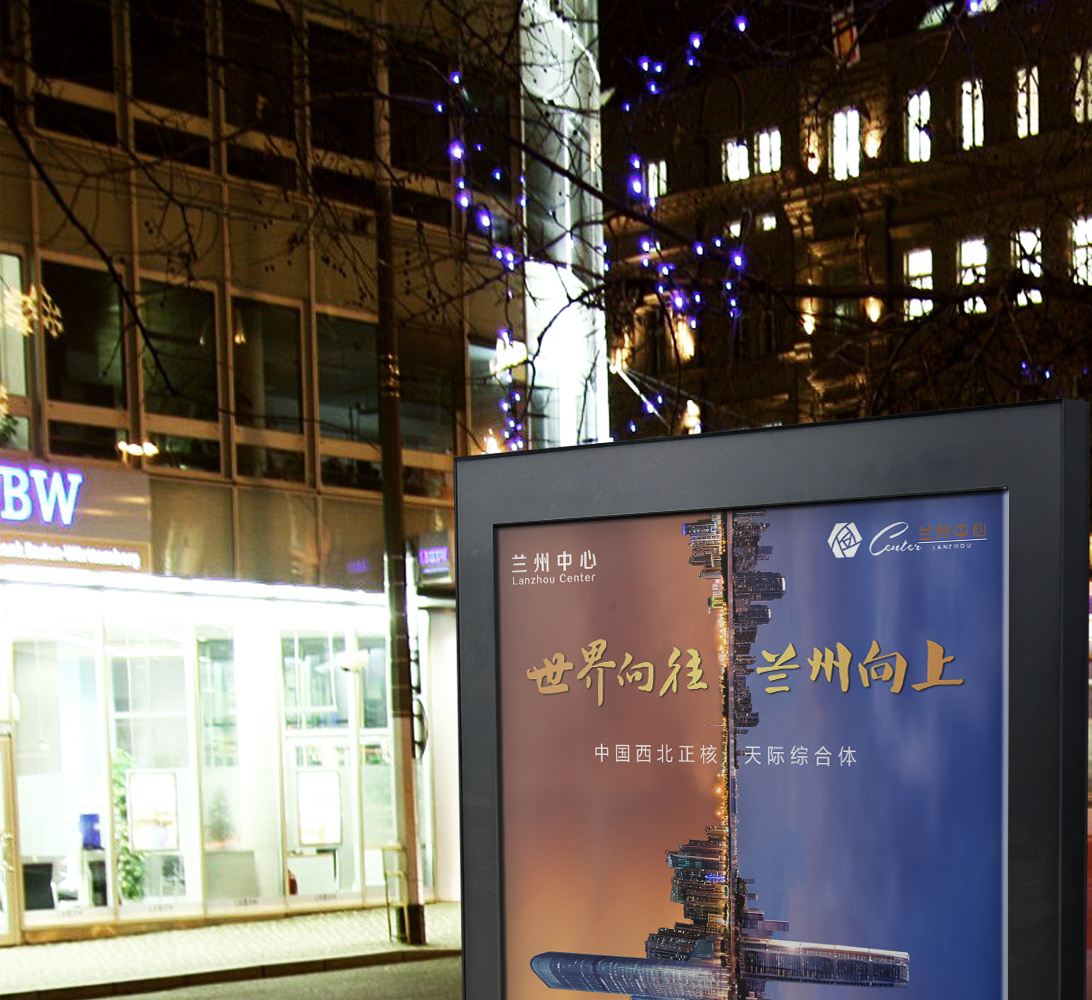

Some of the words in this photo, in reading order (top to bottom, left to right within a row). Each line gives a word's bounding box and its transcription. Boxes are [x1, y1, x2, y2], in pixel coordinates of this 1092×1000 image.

[869, 521, 923, 556] Center
[918, 521, 987, 541] 兰州中心
[932, 543, 972, 551] LANZHOU
[511, 549, 597, 573] 兰州中心
[512, 574, 555, 586] Lanzhou
[559, 572, 596, 583] Center
[526, 638, 708, 706] 世界向往
[756, 640, 965, 695] 兰州向上
[593, 743, 718, 766] 中国西北正核
[744, 745, 858, 768] 天际综合体
